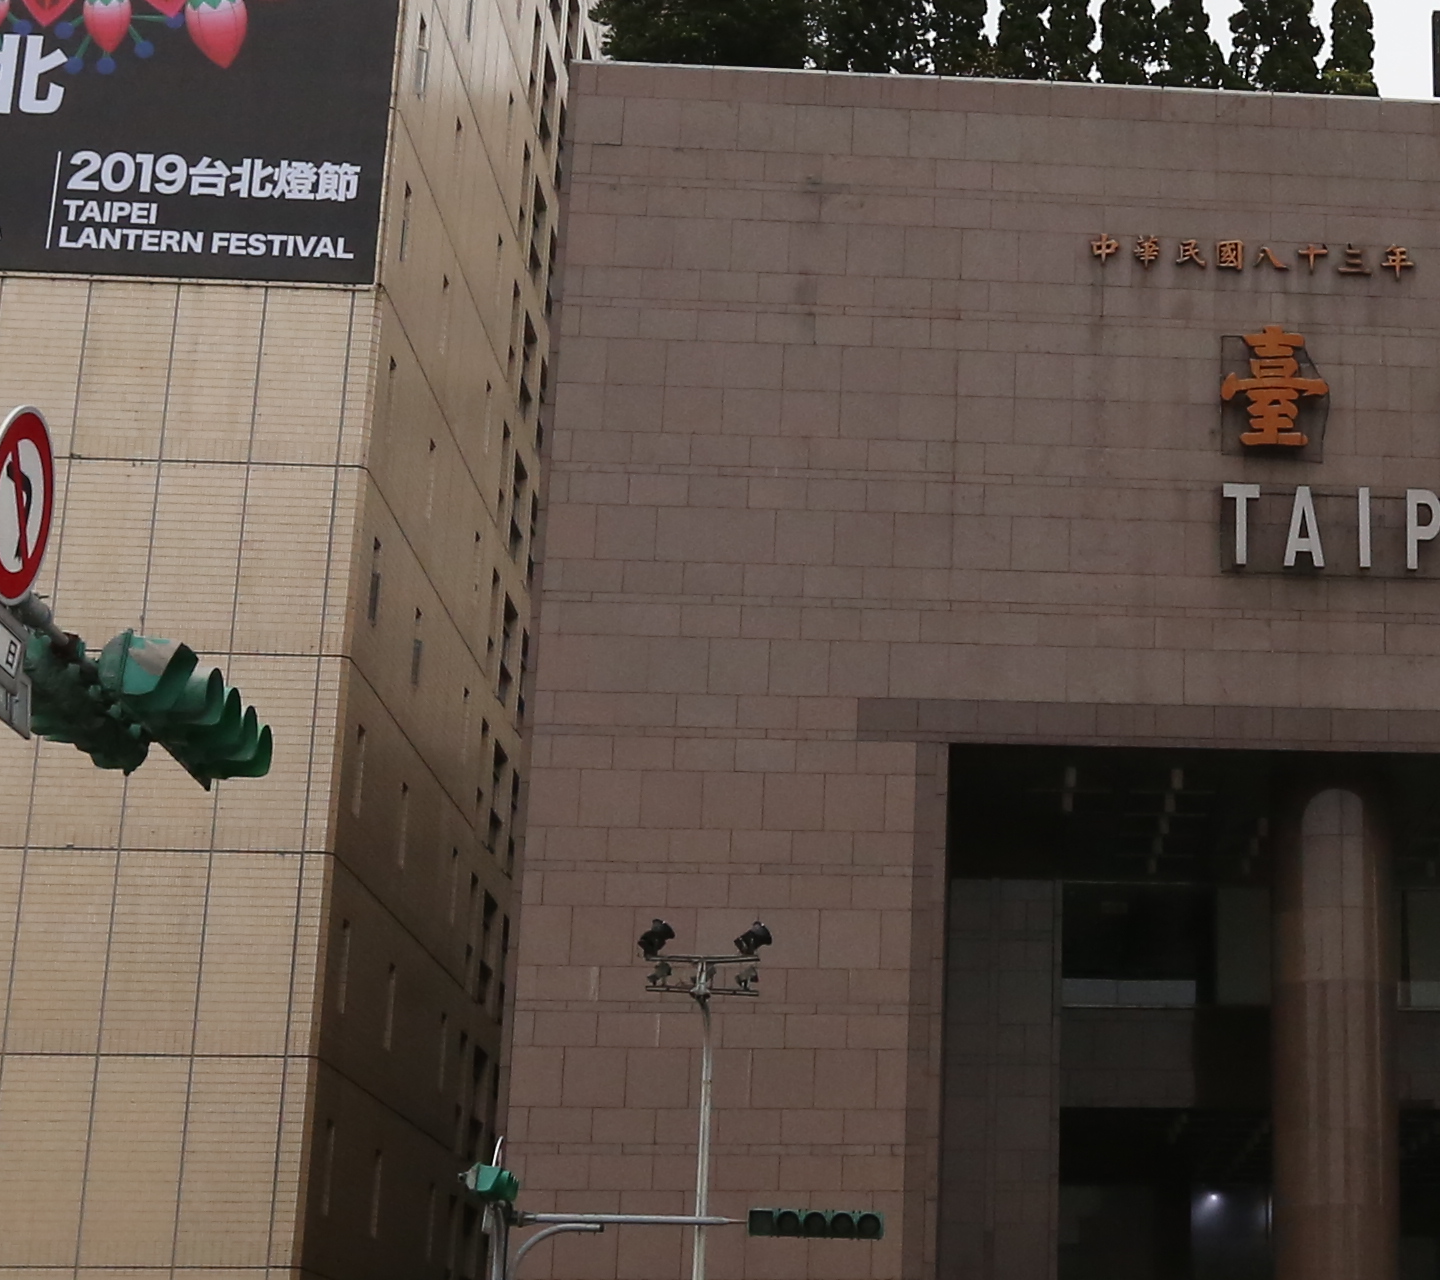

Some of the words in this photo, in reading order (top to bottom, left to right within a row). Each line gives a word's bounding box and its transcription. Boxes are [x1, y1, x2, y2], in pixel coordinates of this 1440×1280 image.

[66, 150, 361, 202] 2019台北燈節
[62, 199, 158, 224] TAIPEI
[58, 226, 204, 253] LANTERN
[210, 232, 354, 259] FESTIVAL
[1090, 233, 1414, 278] 中華民國八十三年
